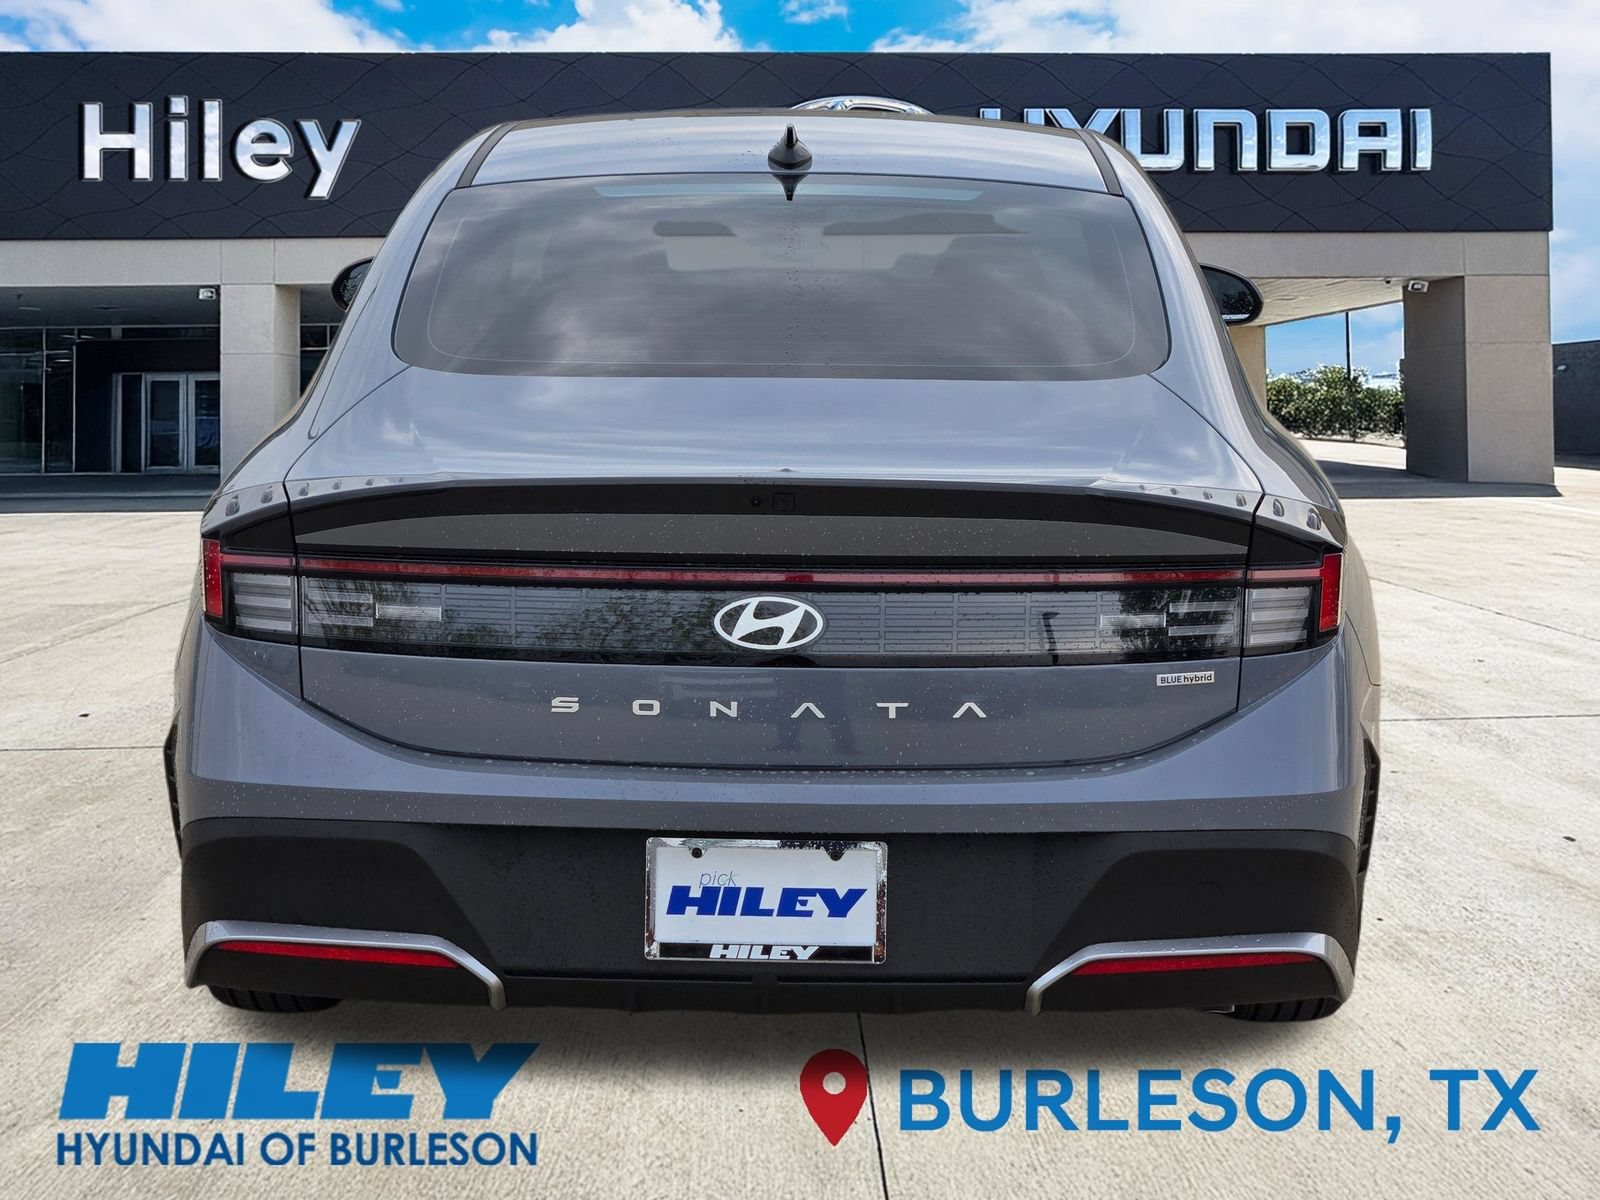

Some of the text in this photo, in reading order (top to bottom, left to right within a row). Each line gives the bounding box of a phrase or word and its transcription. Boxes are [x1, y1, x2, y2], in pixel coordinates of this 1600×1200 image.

[80, 95, 362, 200] Hiley
[980, 107, 1433, 172] YUNDAI
[1160, 673, 1212, 684] BLUE hybrid
[550, 696, 987, 719] SONATA
[698, 870, 737, 889] pick
[666, 885, 867, 918] HILEY
[709, 944, 820, 961] HILEY
